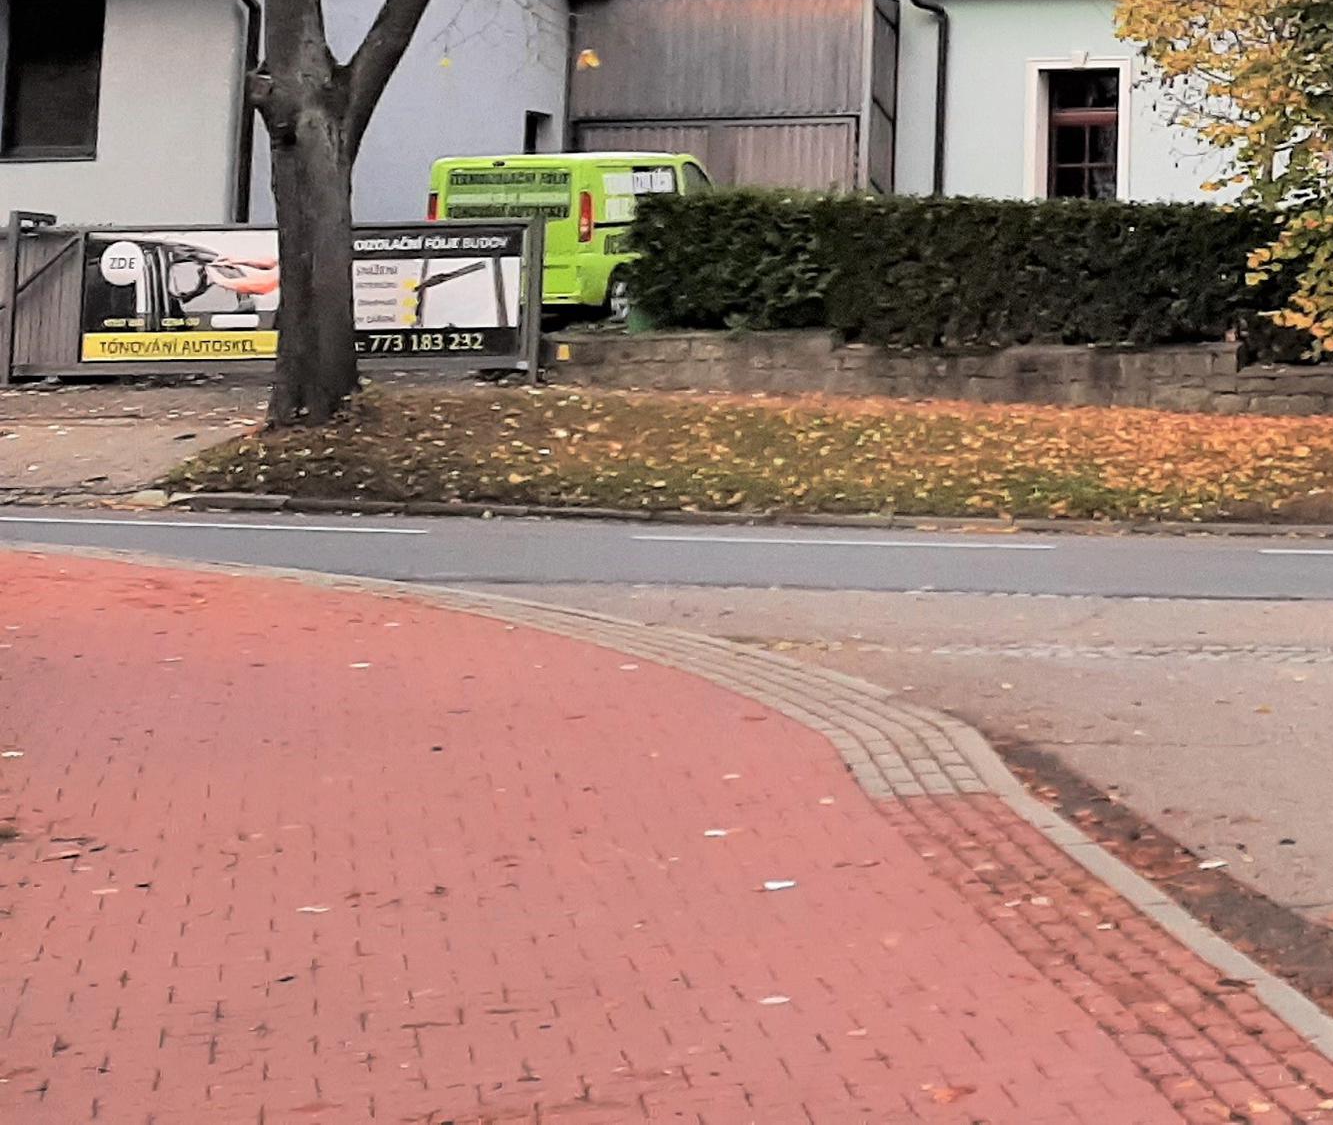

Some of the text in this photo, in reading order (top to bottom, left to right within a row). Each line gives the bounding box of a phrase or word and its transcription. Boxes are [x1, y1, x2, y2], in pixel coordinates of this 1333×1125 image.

[109, 257, 136, 270] ZDE
[369, 334, 403, 352] 773
[410, 334, 444, 352] 183
[448, 332, 485, 351] 232
